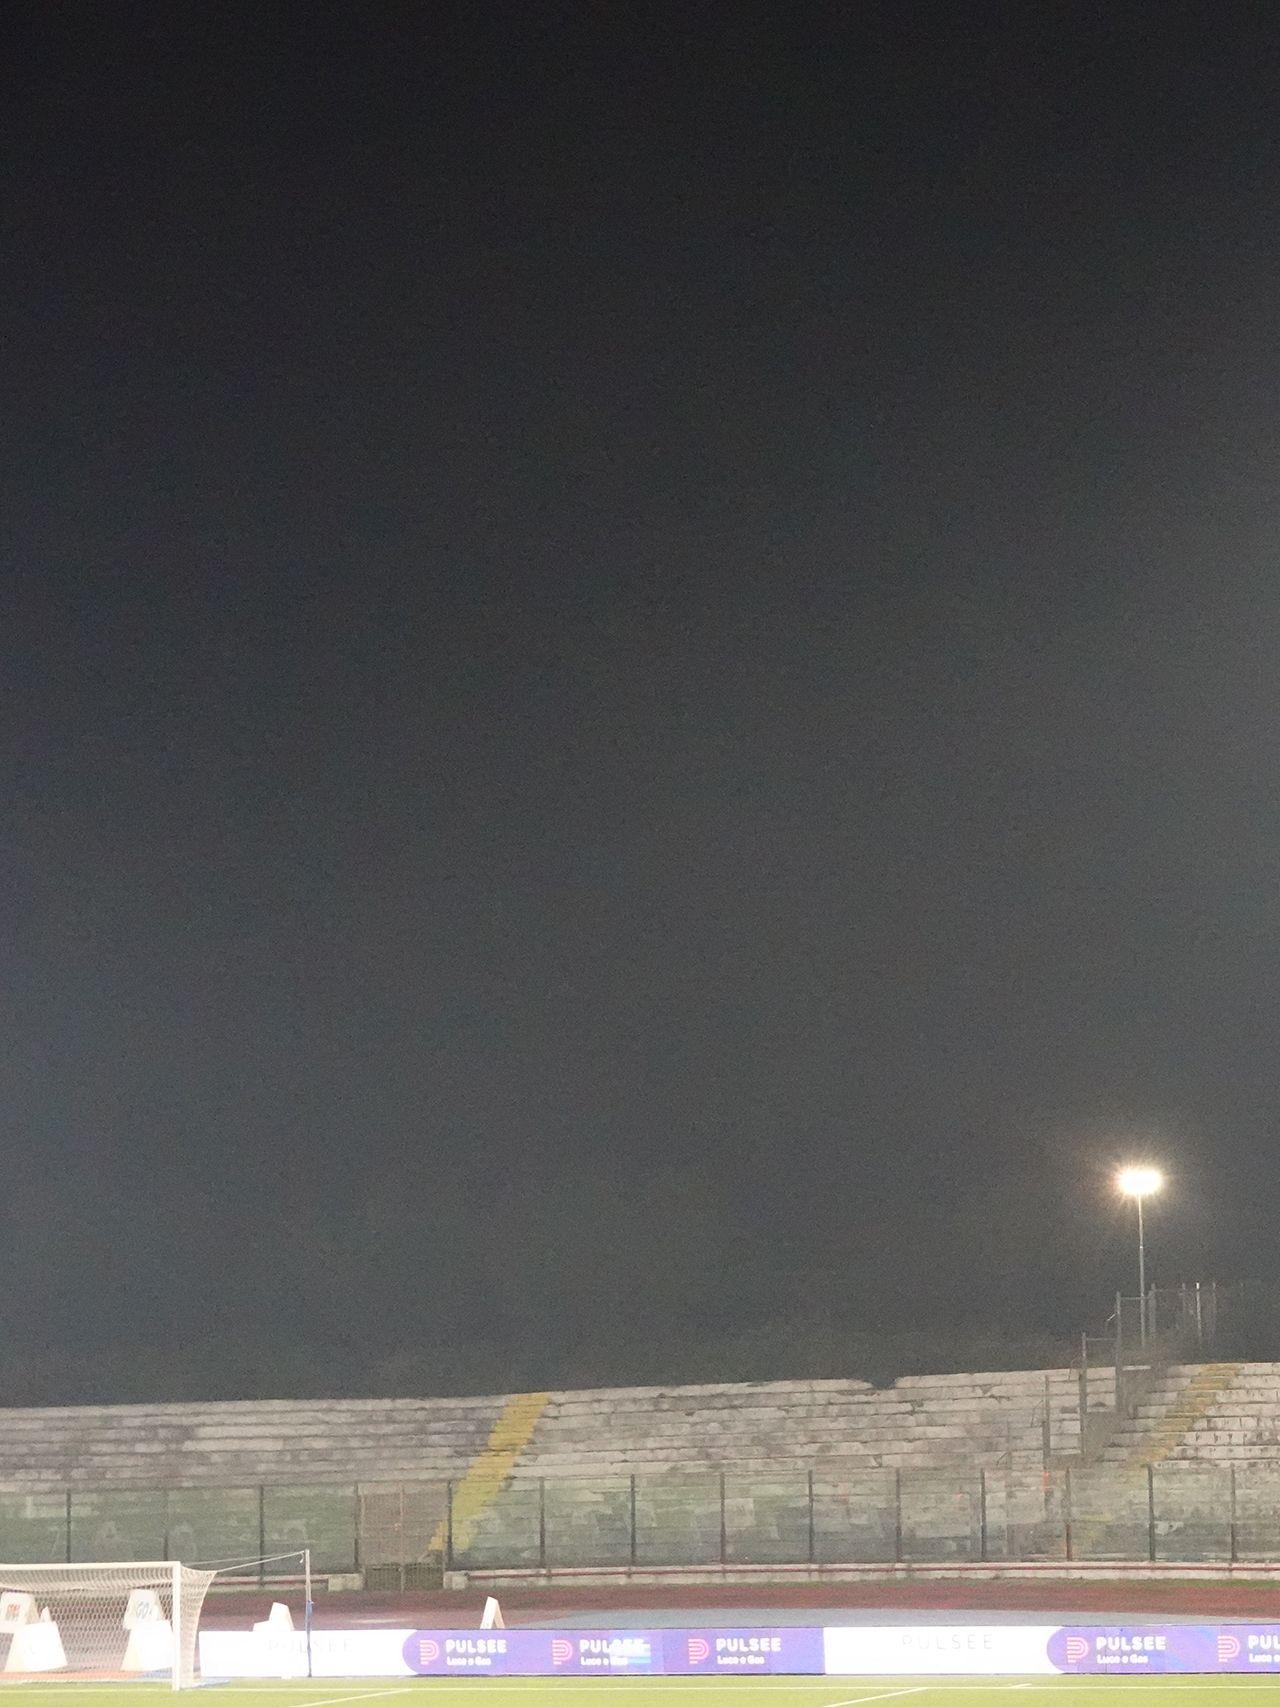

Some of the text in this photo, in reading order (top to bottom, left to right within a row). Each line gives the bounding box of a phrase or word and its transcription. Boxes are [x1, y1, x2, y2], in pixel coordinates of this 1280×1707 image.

[445, 1639, 507, 1653] PULSEE
[716, 1638, 782, 1652] PULSEE
[1096, 1636, 1167, 1650] PULSEE
